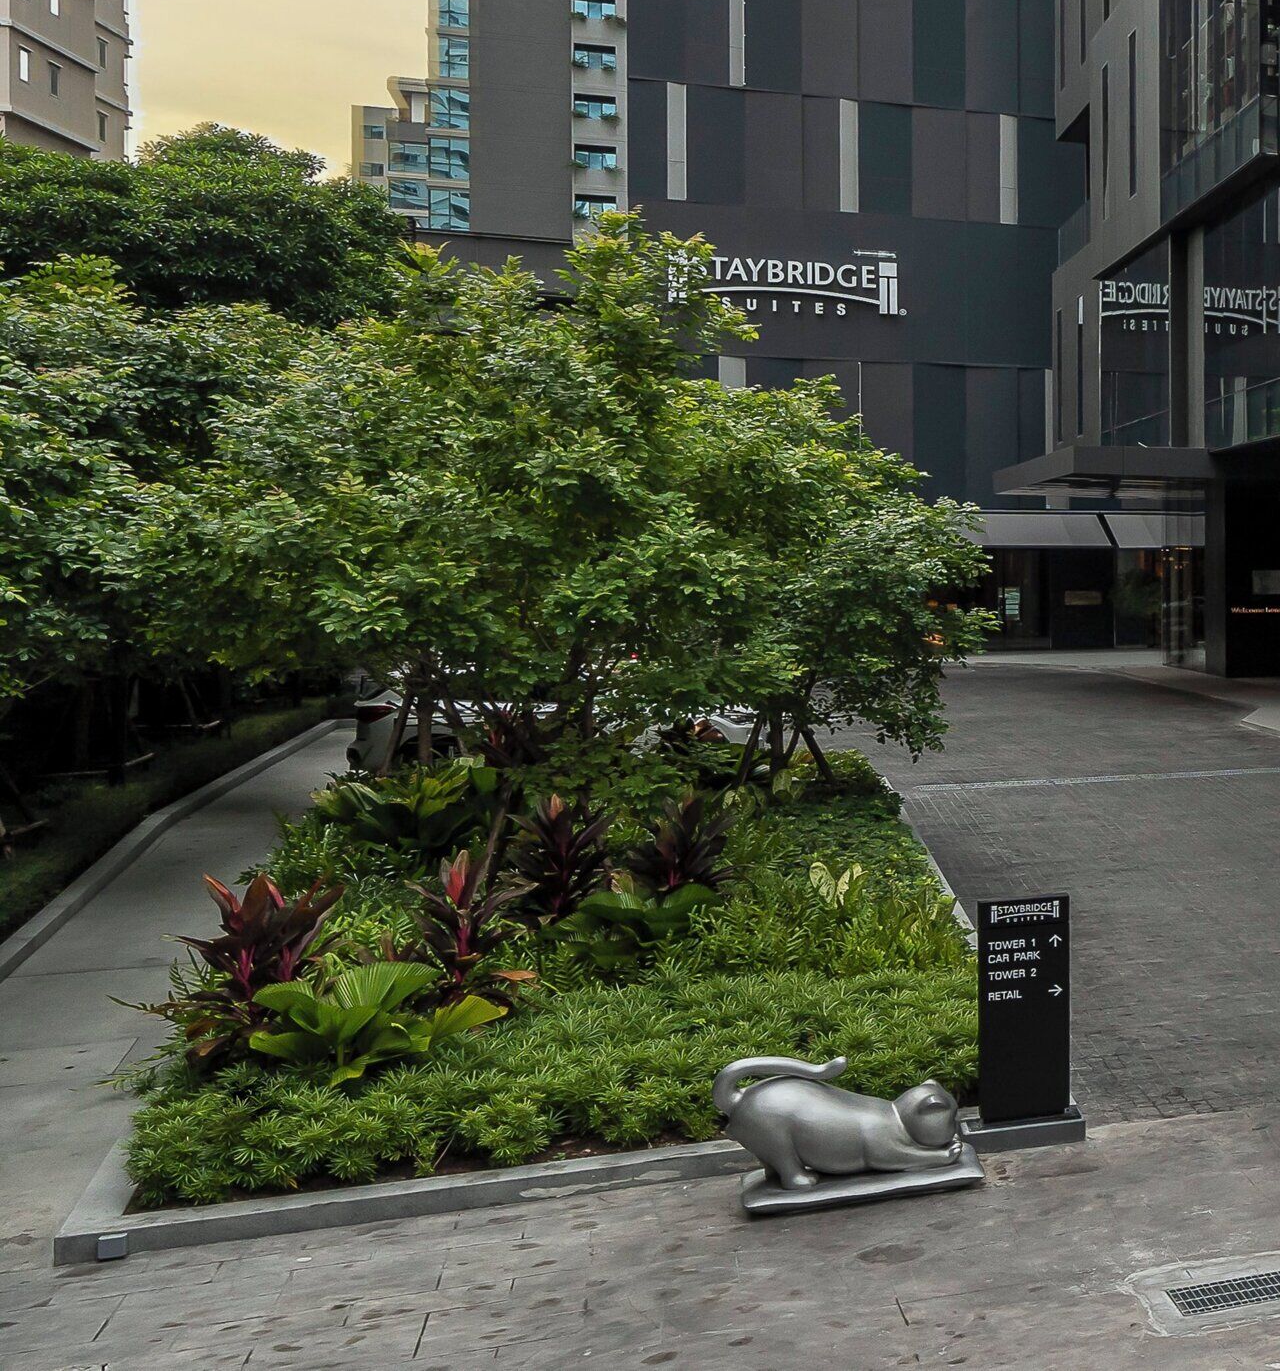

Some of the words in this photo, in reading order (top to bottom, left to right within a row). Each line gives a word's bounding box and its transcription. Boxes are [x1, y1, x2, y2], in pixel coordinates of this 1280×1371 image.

[721, 297, 847, 316] SUITES
[998, 902, 1052, 914] STAYBRIDGE
[1006, 915, 1044, 923] SUITES
[988, 939, 1025, 950] TOWER
[1031, 938, 1036, 947] 1
[988, 953, 1009, 963] CAR
[1014, 950, 1041, 962] PARK
[988, 969, 1025, 981] TOWER
[1030, 968, 1037, 977] 2
[988, 990, 1022, 1001] RETAIL
